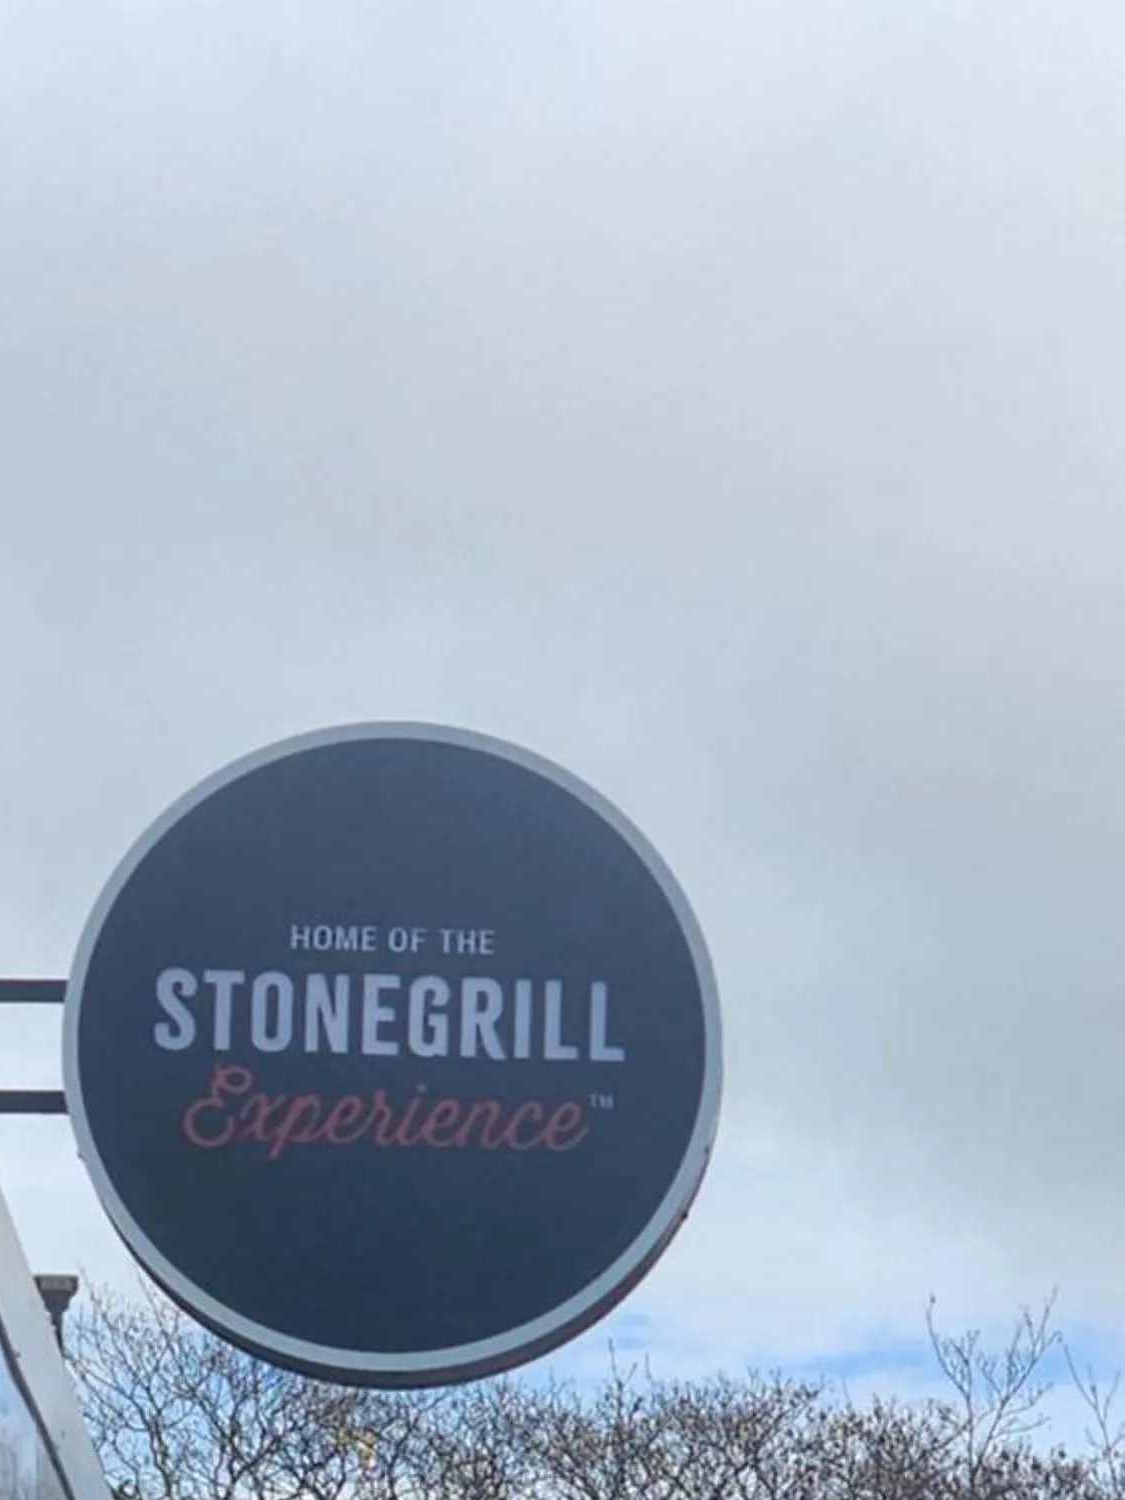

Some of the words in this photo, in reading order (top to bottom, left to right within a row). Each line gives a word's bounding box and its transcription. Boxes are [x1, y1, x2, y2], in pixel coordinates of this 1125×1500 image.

[290, 924, 377, 952] HOME
[388, 927, 427, 953] OF
[441, 928, 496, 955] THE
[153, 967, 626, 1062] STONEGRILL
[182, 1063, 589, 1160] Experience
